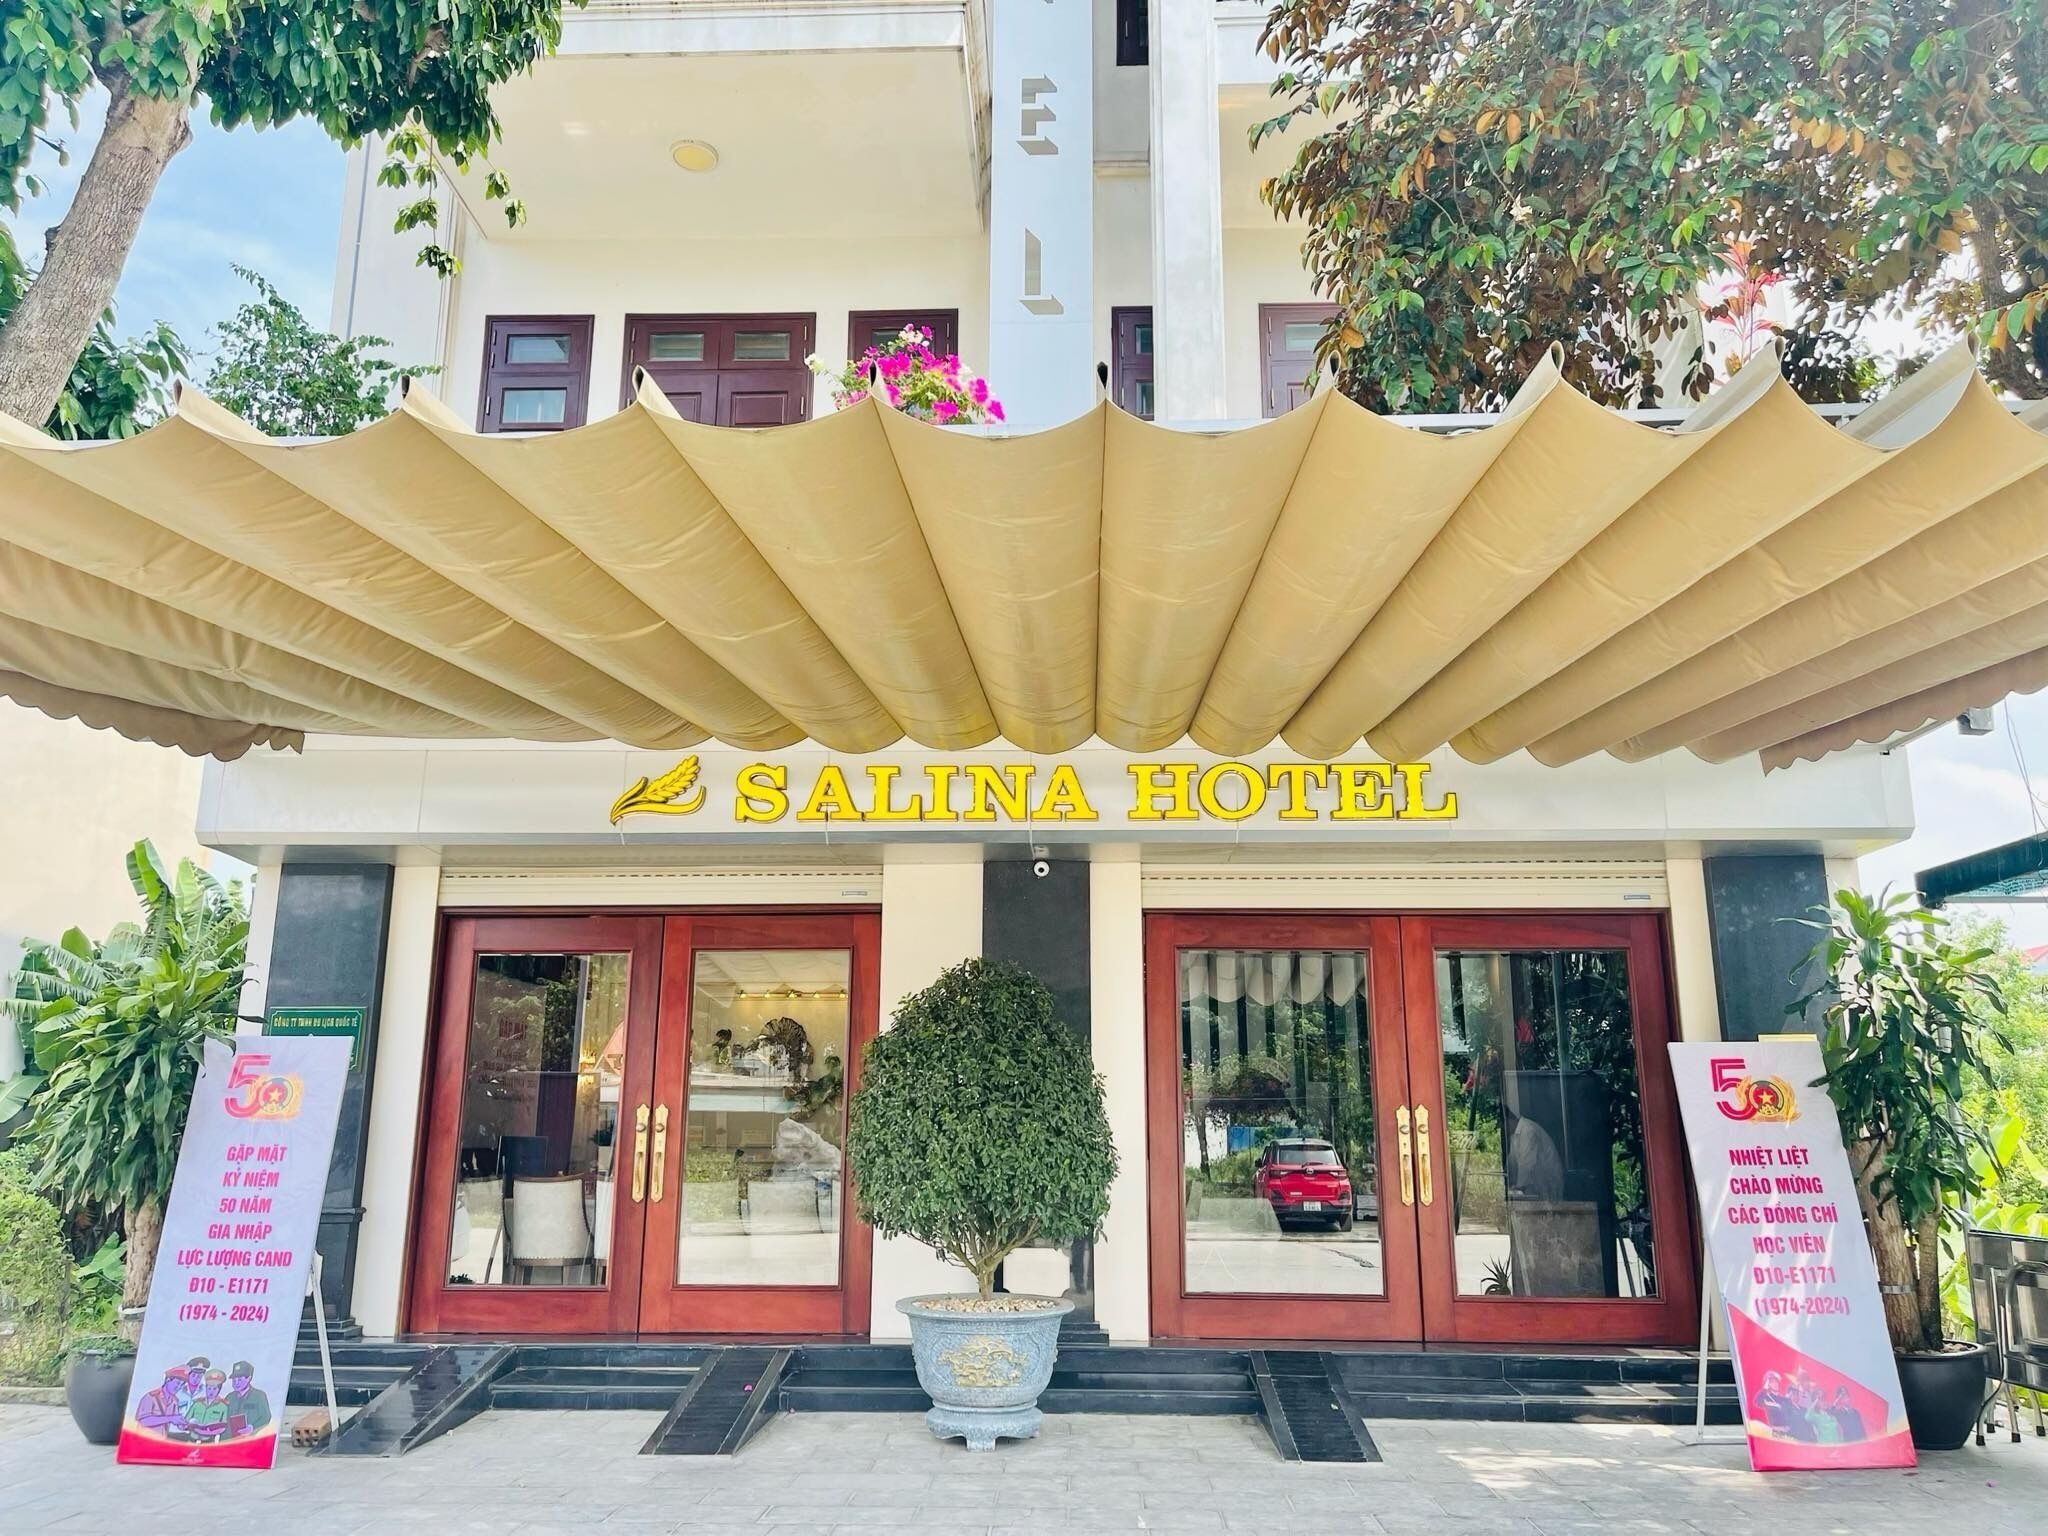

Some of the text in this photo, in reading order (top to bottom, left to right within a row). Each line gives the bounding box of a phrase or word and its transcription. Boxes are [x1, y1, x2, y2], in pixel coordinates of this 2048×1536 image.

[735, 761, 1458, 822] SALINA HOTEL
[226, 1143, 287, 1165] GẶP MẶT
[1728, 1145, 1809, 1169] NHIỆT LIỆT
[222, 1167, 280, 1191] KỶ NIỆM
[1730, 1174, 1823, 1195] CHÀO MỪNG
[219, 1195, 272, 1213] 50 NĂM
[1728, 1201, 1838, 1224] CÁC ĐỒNG CHÍ
[208, 1221, 272, 1244] GIA NHẬP
[1753, 1232, 1826, 1257] HỌC VIÊN
[177, 1249, 293, 1270] LỰC LƯỢNG CAND
[189, 1277, 216, 1293] Đ10
[228, 1278, 269, 1294] E1171
[1753, 1266, 1836, 1284] Đ10-E1171
[179, 1304, 217, 1321] (1974
[230, 1305, 269, 1323] 2024)
[1754, 1296, 1850, 1317] (1974-2024)
